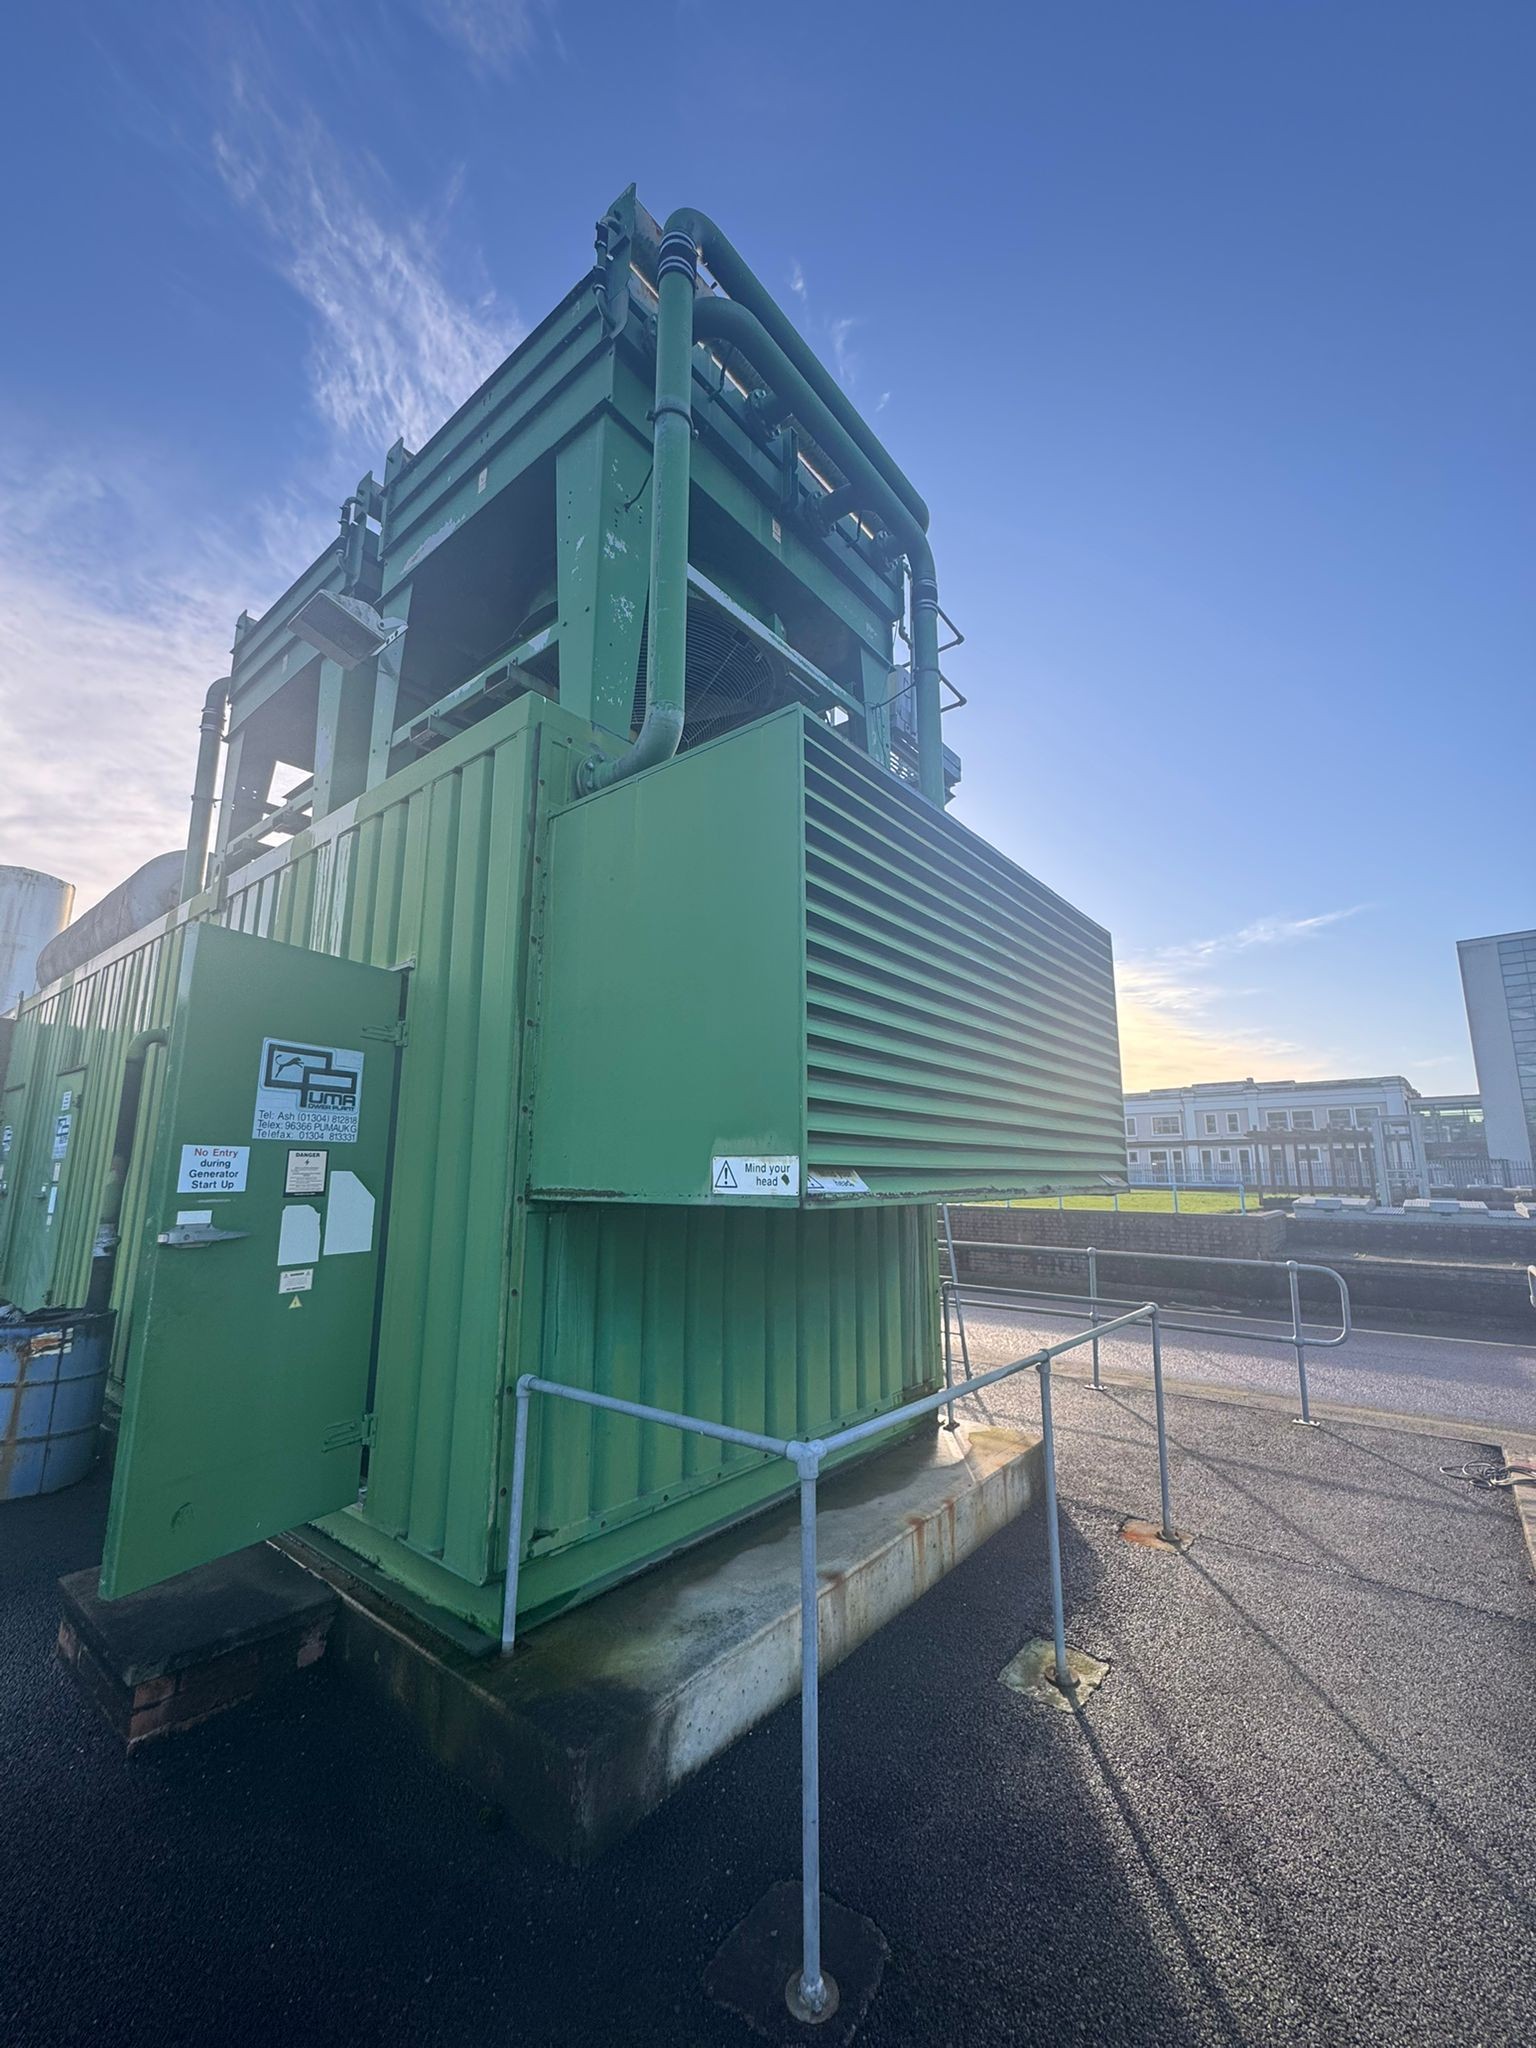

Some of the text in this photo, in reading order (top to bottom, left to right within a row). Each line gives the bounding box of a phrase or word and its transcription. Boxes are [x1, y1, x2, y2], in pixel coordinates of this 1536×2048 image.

[258, 1109, 275, 1120] Tel:
[277, 1111, 295, 1121] Ash
[297, 1112, 330, 1123] (01304)
[257, 1119, 284, 1130] Telex:
[284, 1121, 312, 1131] 96366
[298, 1131, 324, 1140] 01304
[328, 1132, 356, 1141] 813331
[194, 1147, 238, 1158] No Entry
[200, 1159, 231, 1169] during
[744, 1163, 790, 1176] Mind your
[188, 1169, 239, 1178] Generator
[191, 1180, 235, 1190] Start Up
[756, 1176, 778, 1187] head
